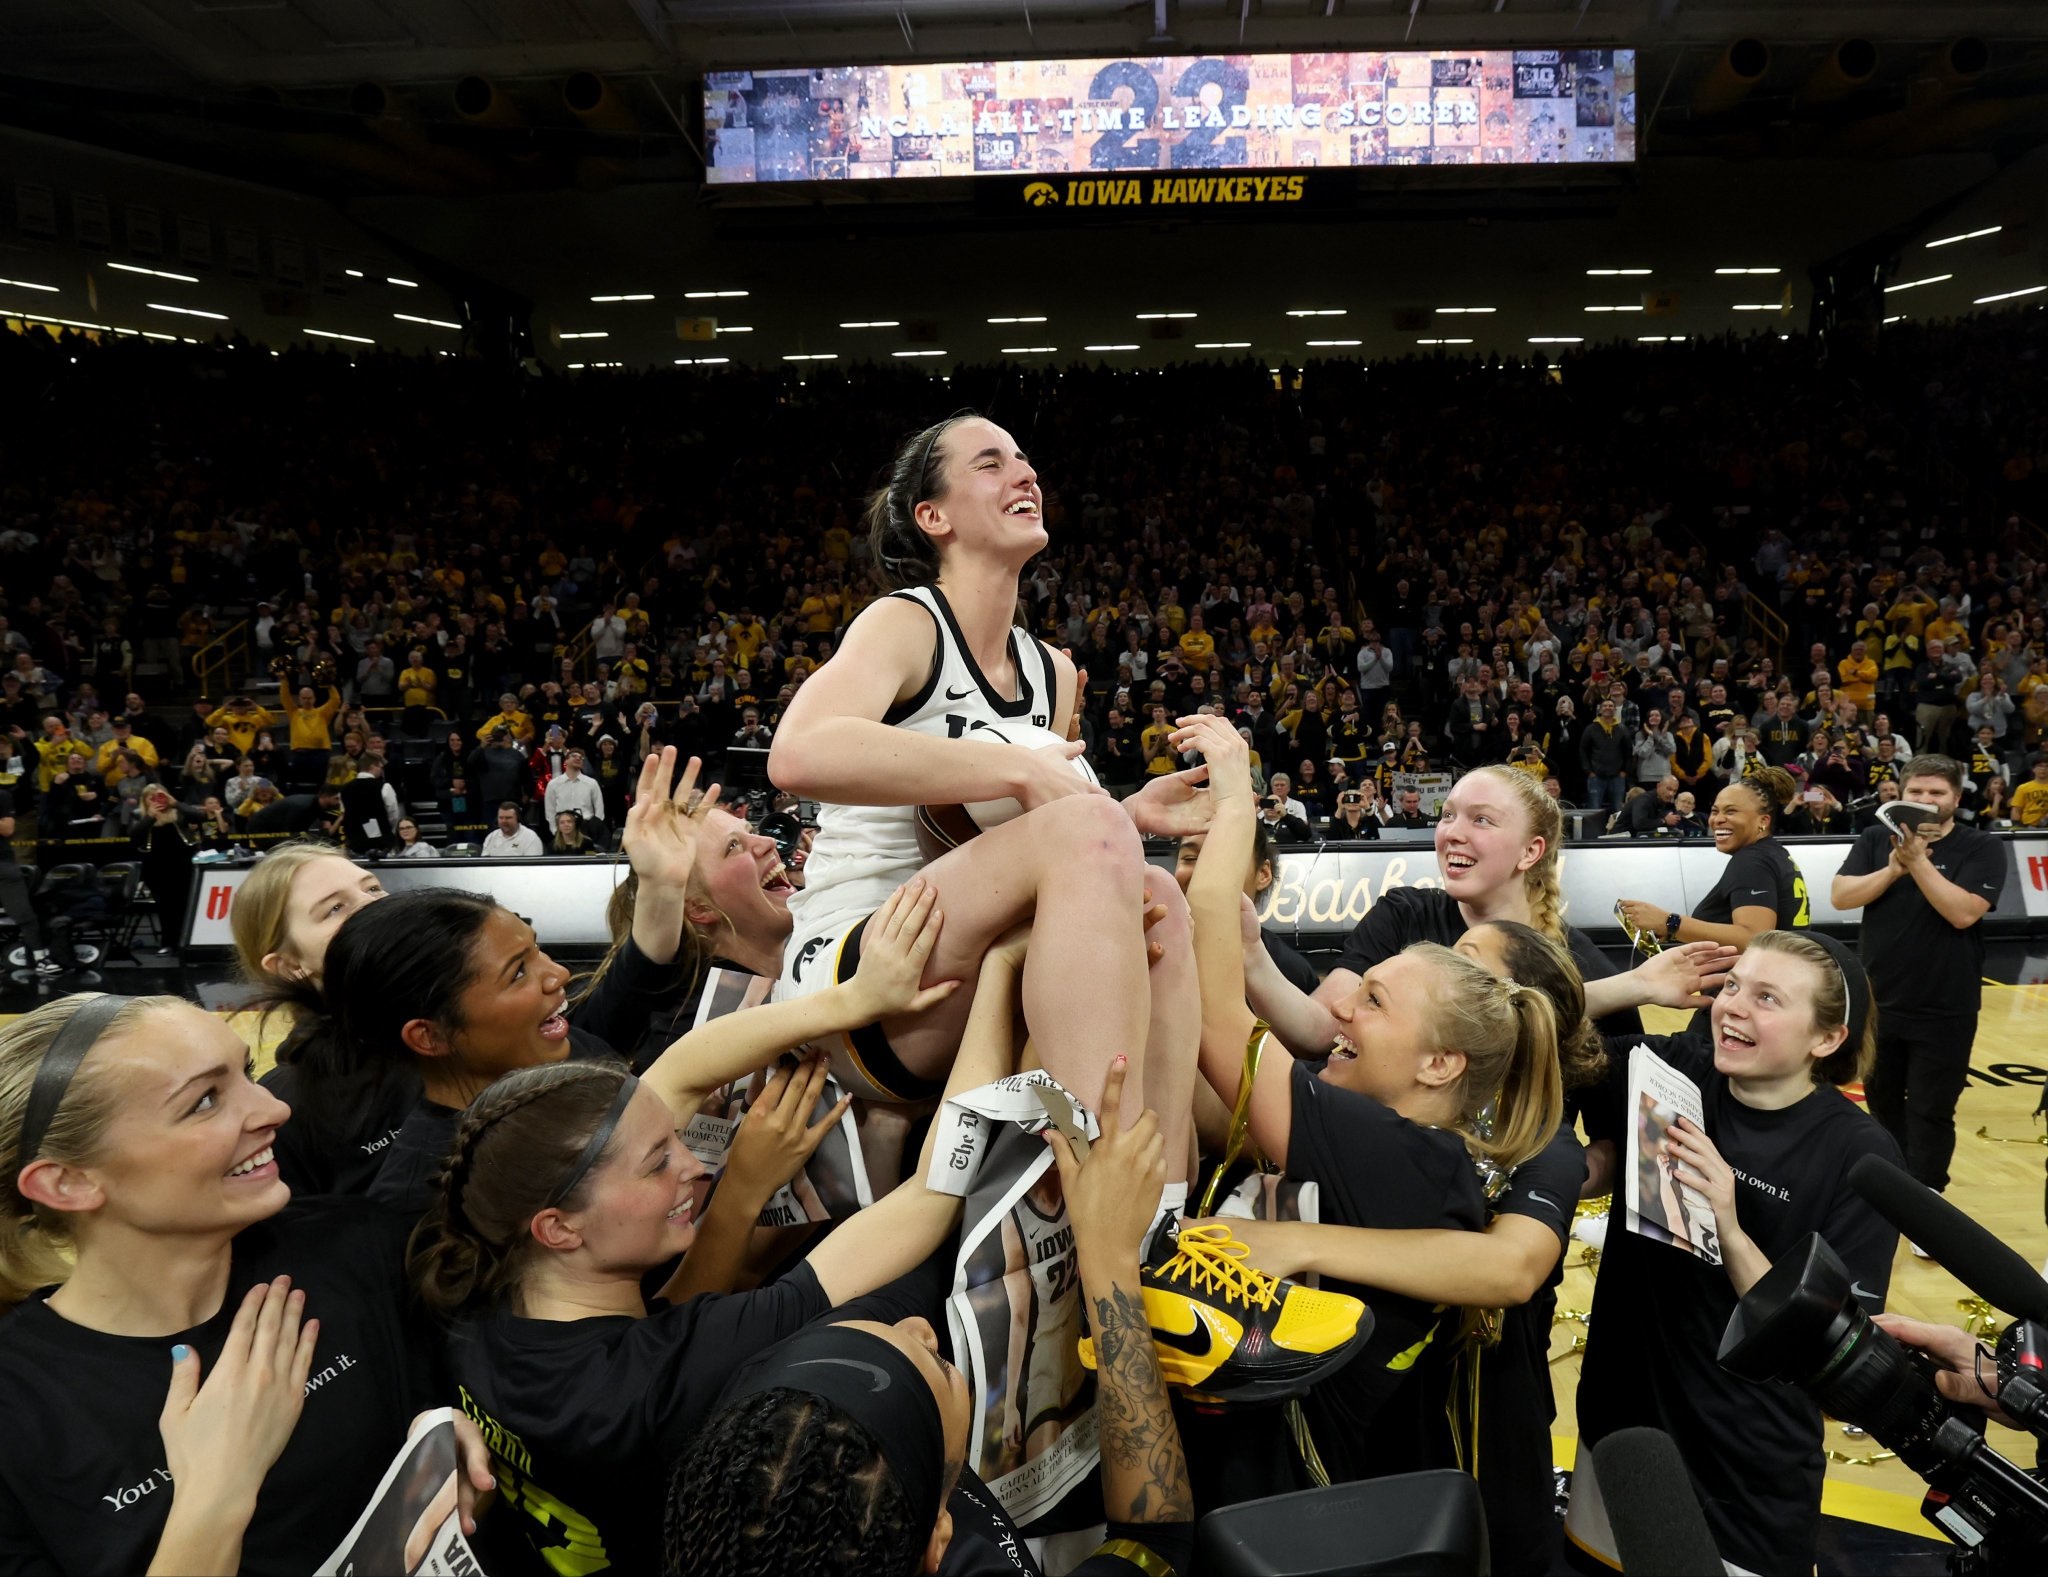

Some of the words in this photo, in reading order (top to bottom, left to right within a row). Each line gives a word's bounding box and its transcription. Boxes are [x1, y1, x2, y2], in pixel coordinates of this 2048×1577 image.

[861, 115, 959, 139] NCAA
[975, 105, 1146, 135] ALL-TIME
[1162, 101, 1322, 129] LEADING
[1339, 98, 1479, 126] SCORER
[1065, 180, 1142, 206] IOWA
[1150, 175, 1304, 204] HAWKEYES
[1769, 729, 1799, 742] IOWA
[360, 1141, 390, 1155] You
[1748, 1176, 1776, 1196] own
[1778, 1187, 1791, 1203] it.
[1036, 1224, 1076, 1264] IOW
[1047, 1246, 1078, 1304] 22
[2016, 1326, 2025, 1343] SONY
[102, 1487, 157, 1512] You
[335, 1353, 357, 1372] it.
[999, 1465, 1037, 1493] CAITLIN
[1036, 1449, 1061, 1472] CLARK
[1971, 1494, 1997, 1518] Canon
